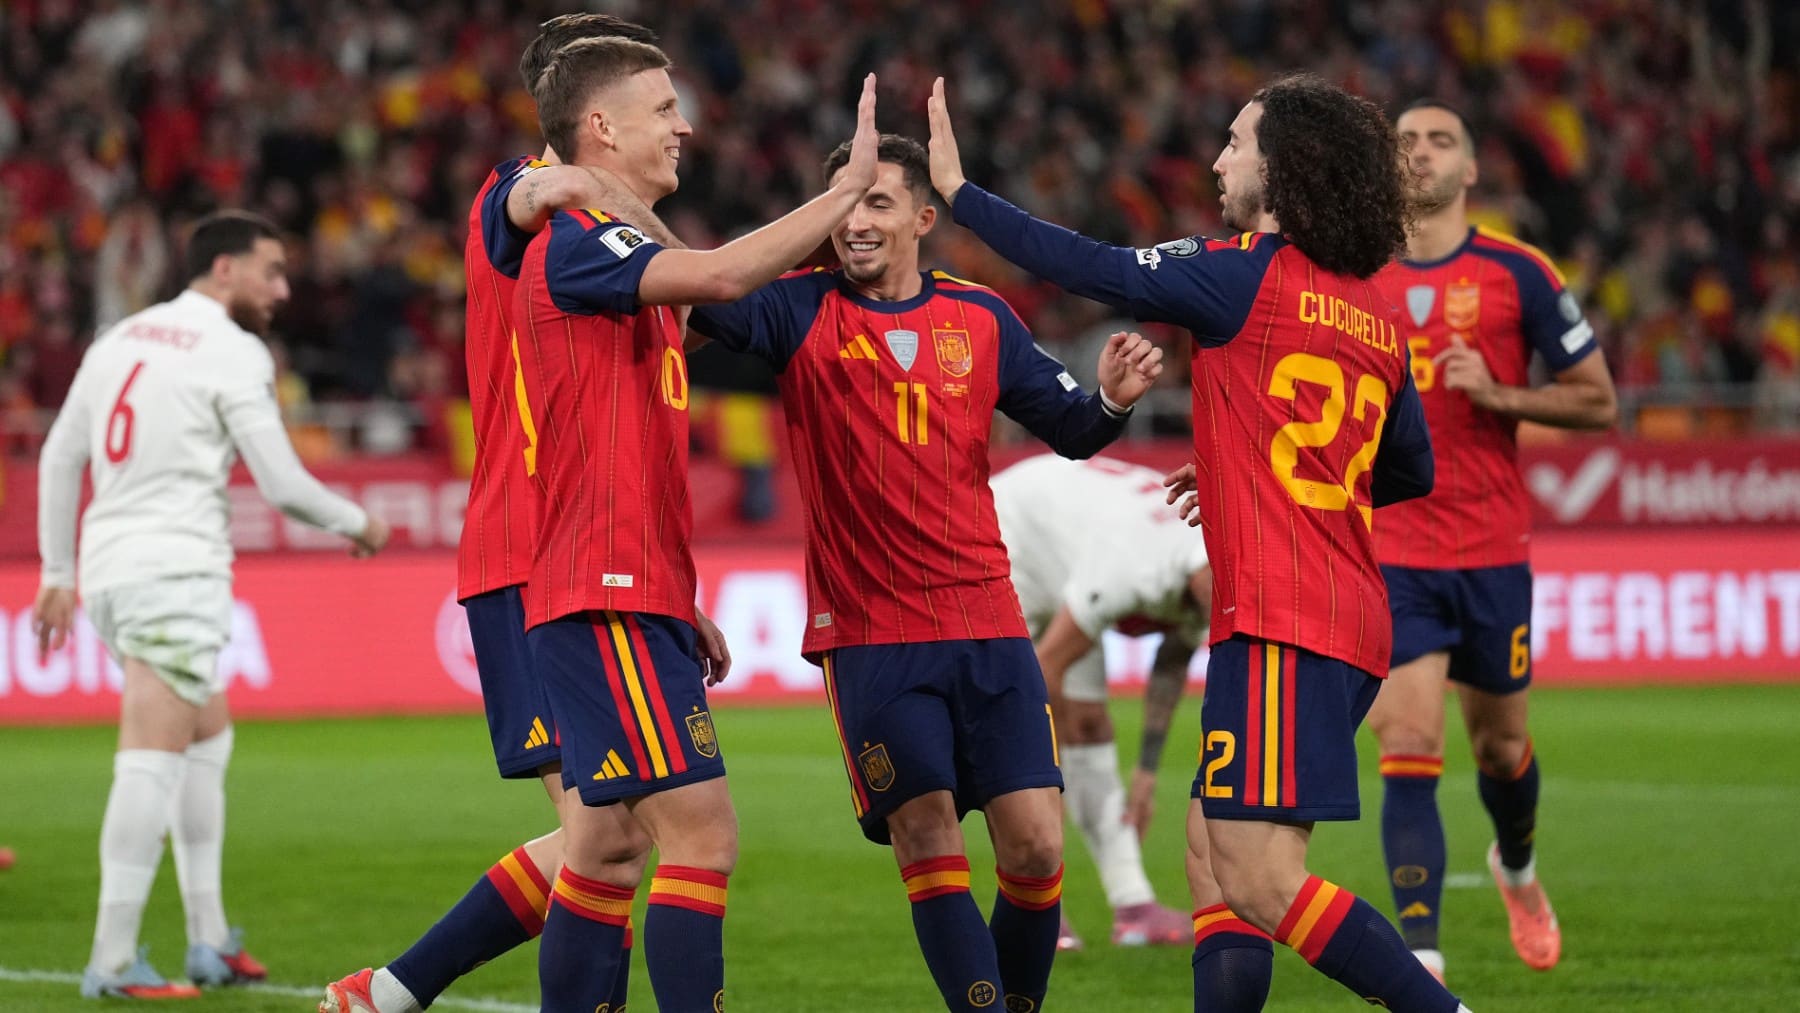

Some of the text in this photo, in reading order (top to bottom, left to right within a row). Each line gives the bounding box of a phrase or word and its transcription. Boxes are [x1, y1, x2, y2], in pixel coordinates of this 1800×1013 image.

[1299, 290, 1399, 358] CUCURELLA
[1408, 337, 1434, 392] 6
[105, 360, 145, 463] 6
[893, 382, 928, 445] 11
[1268, 352, 1388, 534] 22
[1510, 623, 1529, 679] 6
[1199, 730, 1236, 798] 2
